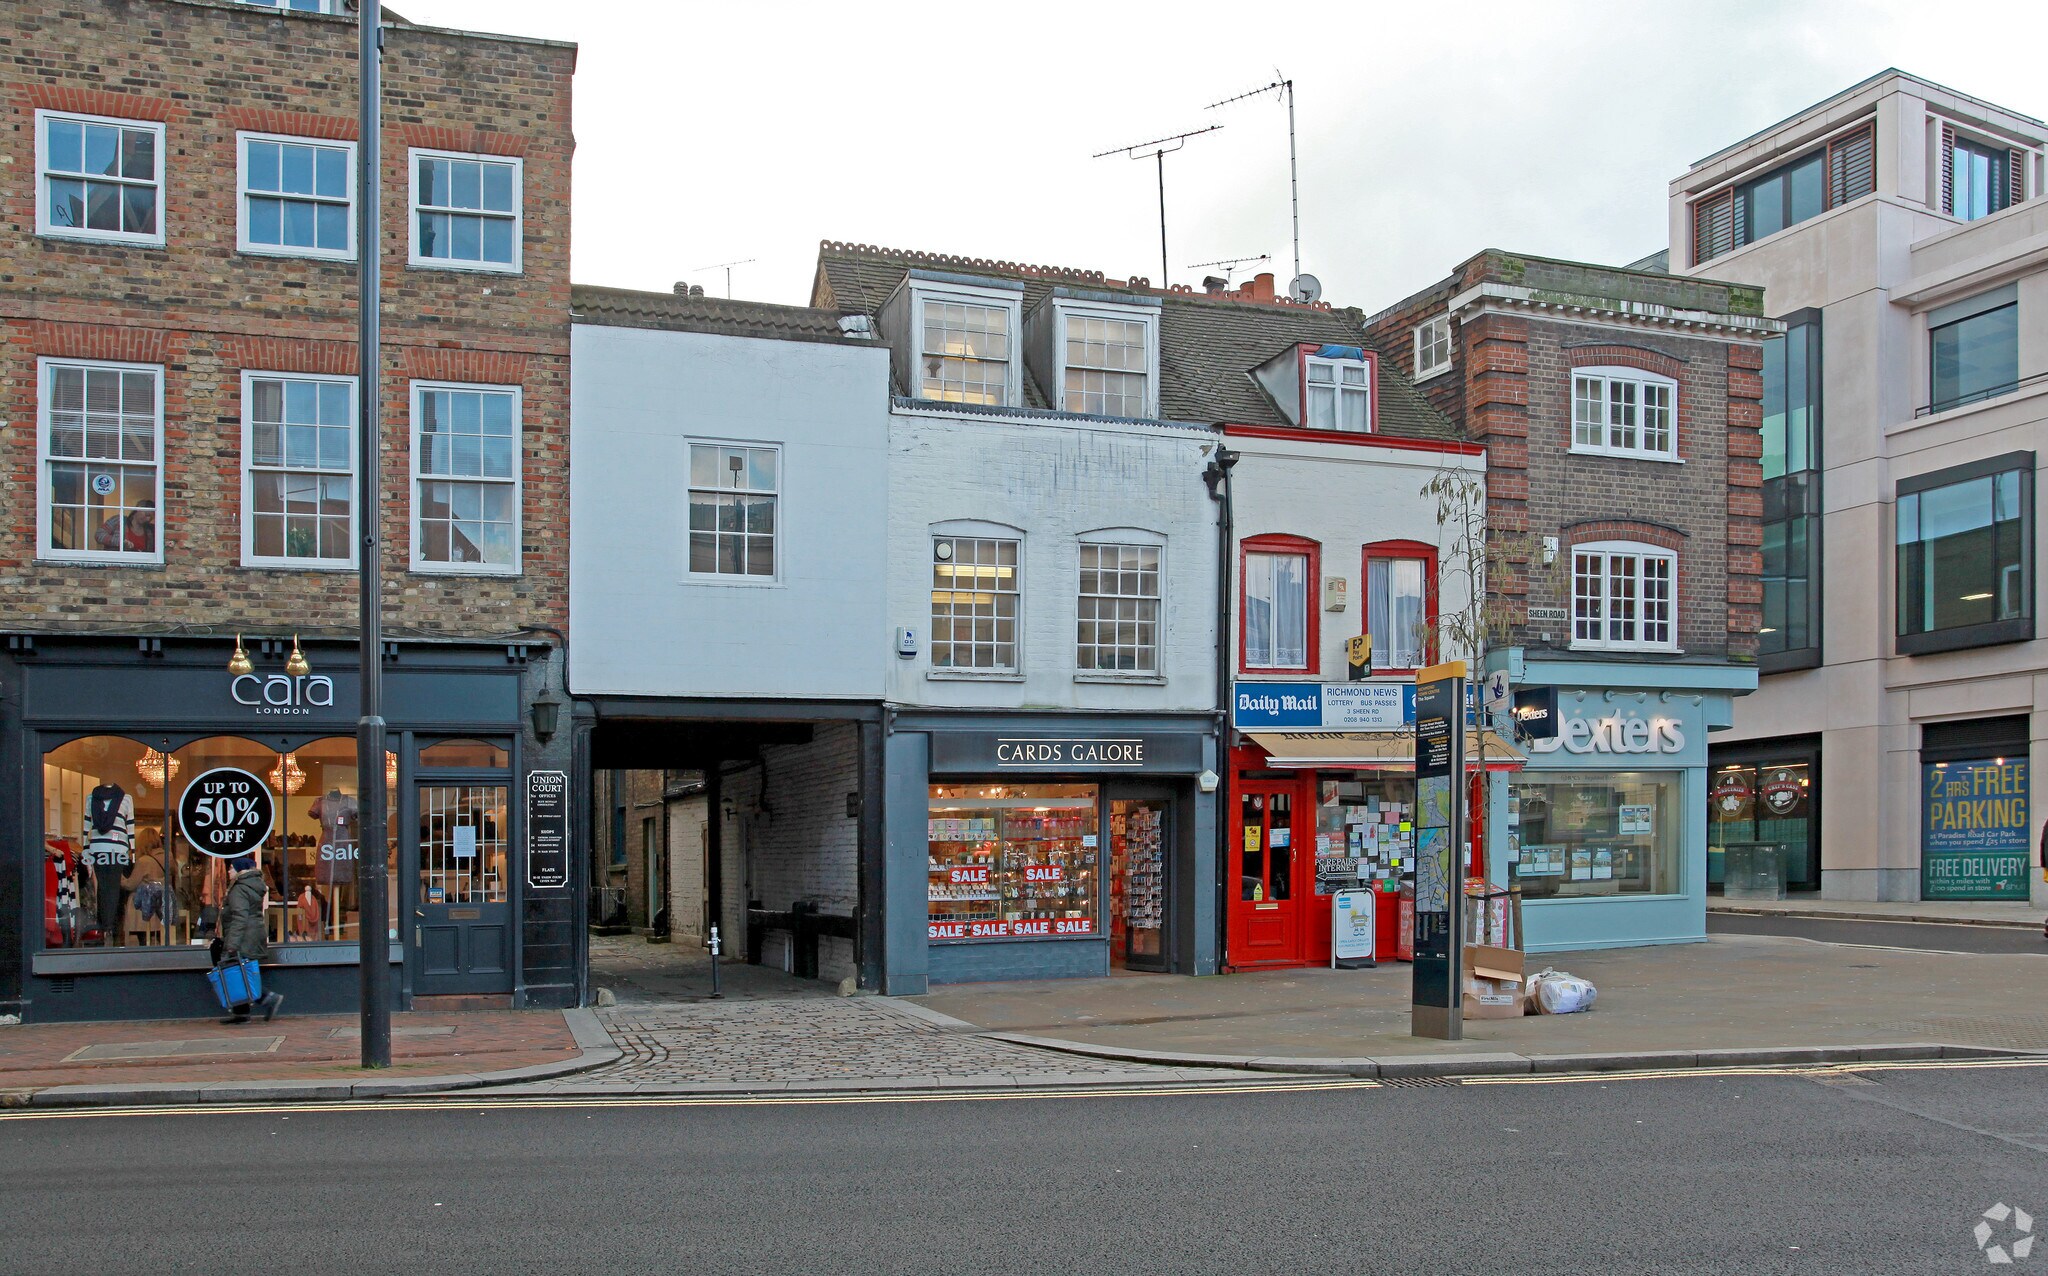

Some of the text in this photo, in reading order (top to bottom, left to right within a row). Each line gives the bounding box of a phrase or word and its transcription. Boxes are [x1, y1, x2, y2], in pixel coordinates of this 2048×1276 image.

[1528, 609, 1566, 619] SHEEN ROAD
[231, 674, 334, 706] cara
[1327, 688, 1398, 697] RICHMOND NEWS
[1239, 693, 1318, 716] Daily Mail
[1516, 707, 1548, 722] Dexters
[997, 744, 1143, 761] CARDS GALORE
[532, 776, 562, 784] UNION
[1930, 764, 2026, 798] 2 HRS FREE
[204, 782, 250, 794] UP TO
[531, 784, 563, 792] COURT
[195, 797, 260, 827] 50%
[1930, 798, 2026, 830] PARKING
[210, 829, 246, 843] OFF
[1949, 840, 1962, 848] you
[1963, 838, 1984, 847] spend
[81, 848, 130, 866] Sale
[1026, 867, 1061, 881] SALE
[1318, 864, 1356, 872] INTERNET
[1929, 857, 2026, 877] FREE DELIVERY
[951, 869, 987, 883] SALE
[1947, 884, 1966, 892] spend
[928, 920, 1091, 938] SALE SALE SALE SALE
